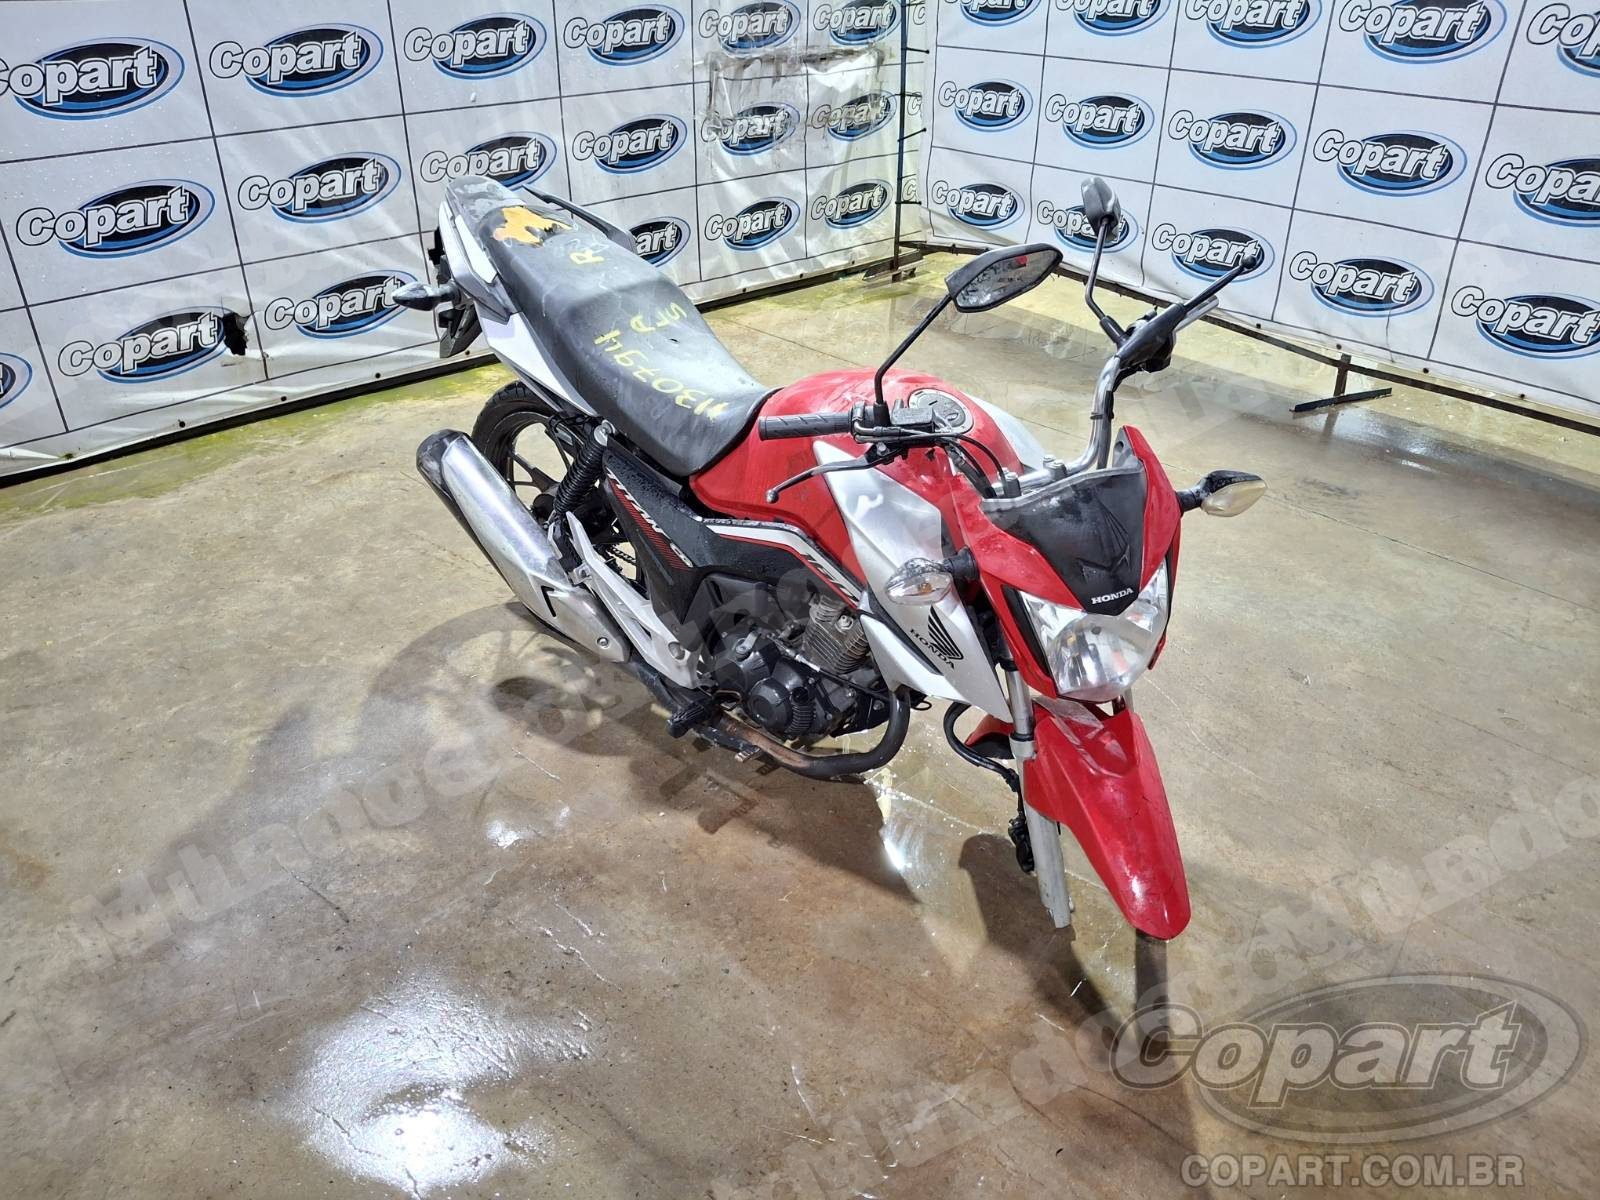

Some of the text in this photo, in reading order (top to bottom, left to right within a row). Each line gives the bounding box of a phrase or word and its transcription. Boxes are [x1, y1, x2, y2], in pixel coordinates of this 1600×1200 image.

[563, 11, 670, 54] Copart
[699, 8, 789, 43] Copart
[813, 3, 892, 37] Copart
[1339, 0, 1488, 44] Copart
[208, 30, 362, 85] Copart
[404, 20, 529, 67] Copart
[0, 45, 159, 106] opart
[812, 96, 887, 131] Copart
[938, 81, 1023, 118] Copart
[1045, 93, 1143, 134] Copart
[572, 119, 674, 164] Copart
[1168, 110, 1283, 154] Copart
[420, 138, 541, 183] Copart
[1313, 129, 1450, 180] Copart
[238, 157, 381, 213] Copart
[932, 180, 1014, 219] Copart
[1486, 153, 1600, 206] Copa
[16, 186, 191, 248] Copart
[705, 201, 788, 242] Copart
[811, 184, 884, 221] Copart
[635, 222, 678, 256] art
[1289, 251, 1418, 304] Copart
[264, 276, 402, 331] Copart
[1451, 285, 1600, 344] Copart
[58, 311, 219, 377] Copart
[1091, 587, 1134, 605] HONDA
[909, 628, 956, 670] HONDA
